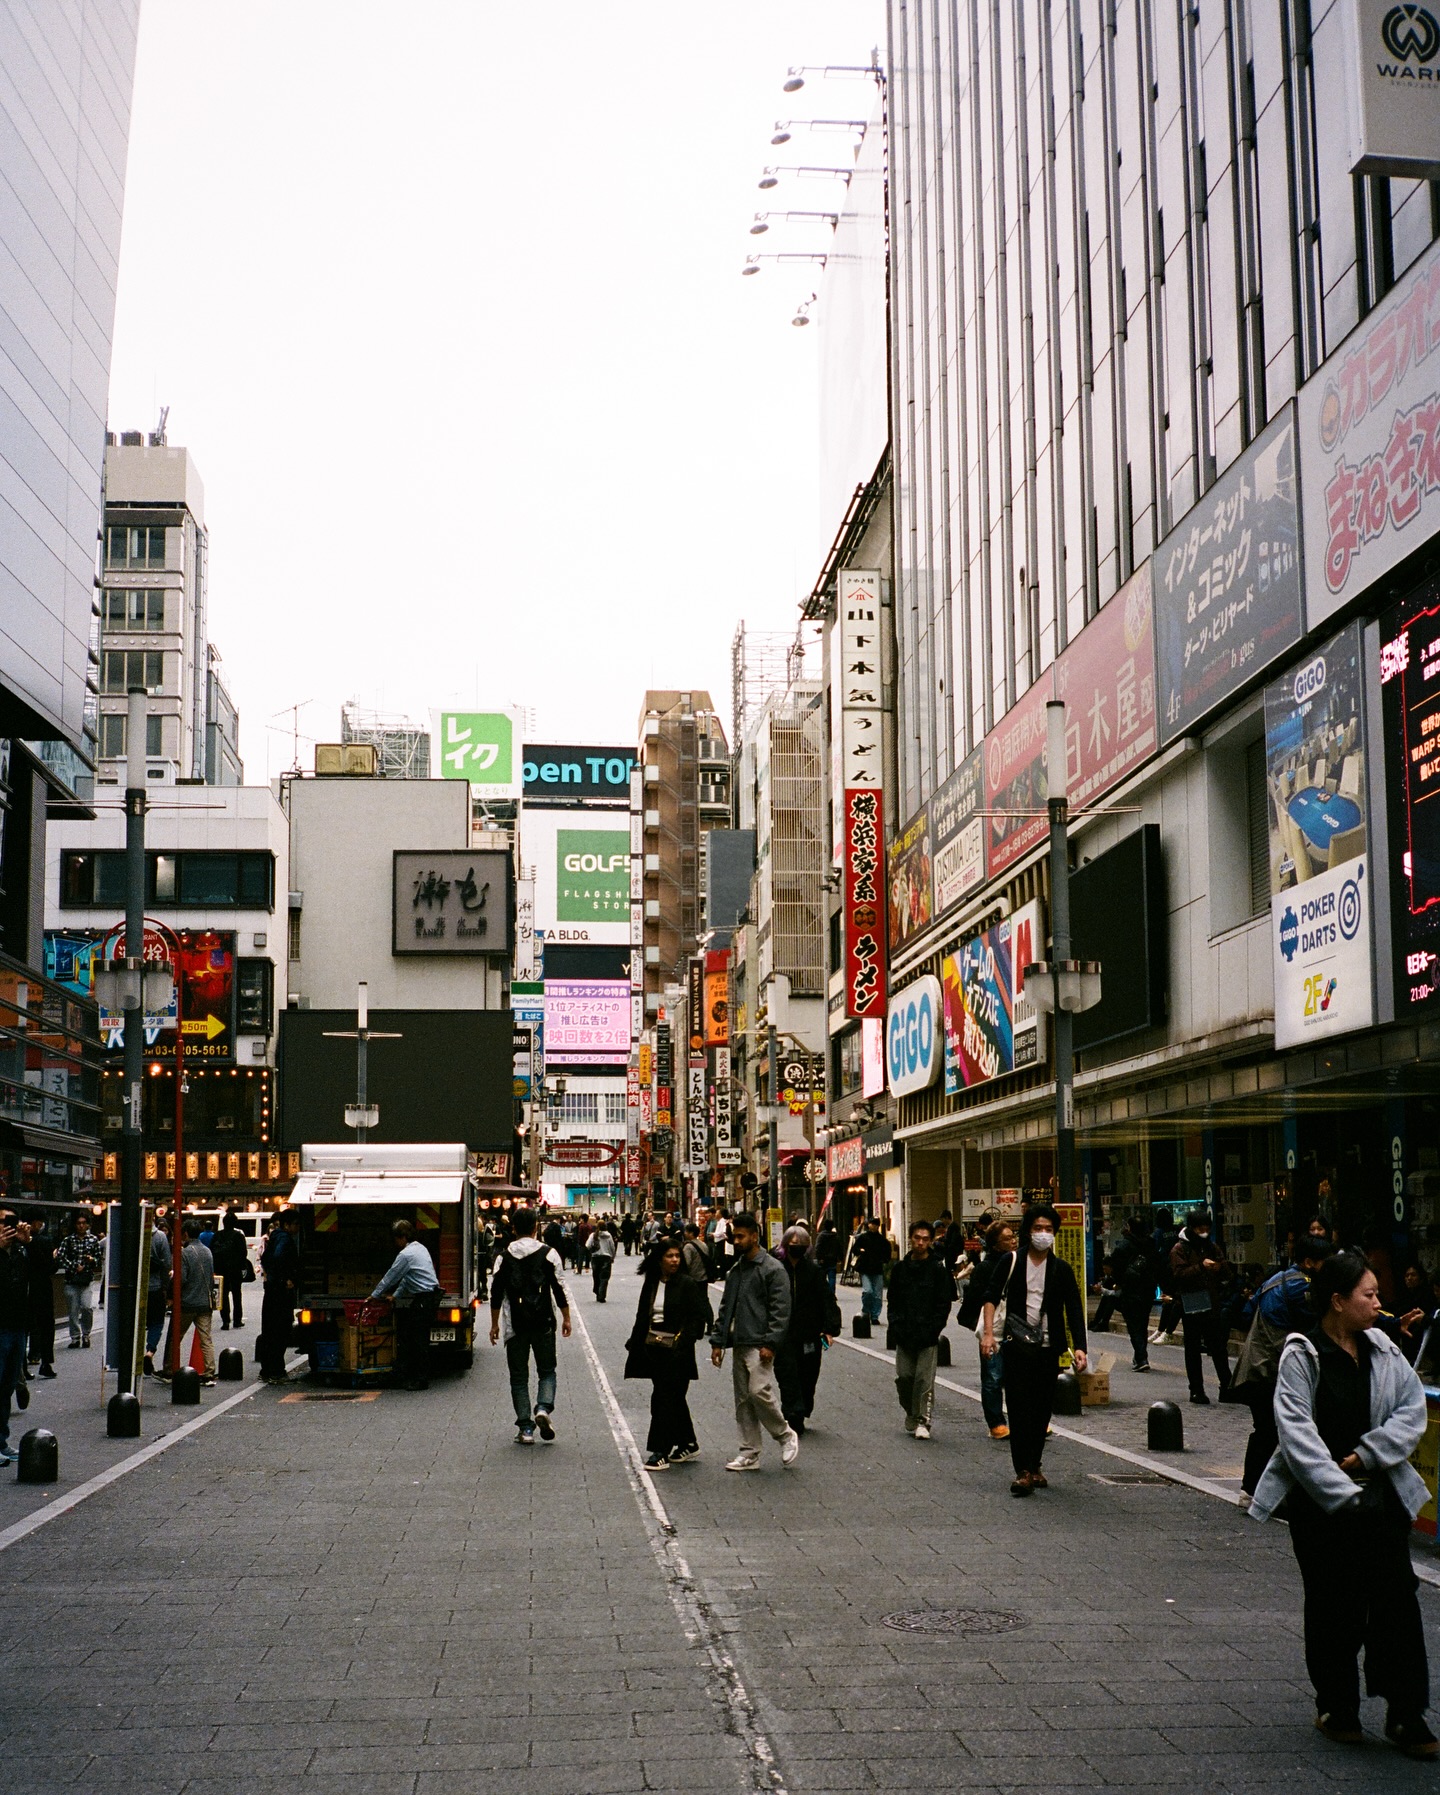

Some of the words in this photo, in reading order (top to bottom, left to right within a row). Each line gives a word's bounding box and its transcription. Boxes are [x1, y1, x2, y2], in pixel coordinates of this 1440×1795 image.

[1377, 64, 1440, 81] WAR
[1165, 476, 1251, 593] インターネット
[1187, 529, 1251, 625] &コミック
[1166, 688, 1181, 725] 4F
[850, 793, 878, 902] 横浜家系
[564, 890, 629, 898] FLAGSHI
[1301, 892, 1336, 924] POKER
[1301, 923, 1337, 953] DARTS
[853, 934, 878, 1013] ラーメン
[962, 943, 994, 983] ゲームの
[549, 1001, 620, 1012] 1位アーティストの
[966, 980, 1000, 1027] オアシスに
[1303, 973, 1323, 1017] 2F
[107, 1028, 160, 1049] KV
[561, 1015, 608, 1026] 推し広告は
[890, 992, 933, 1082] GiGO
[691, 1117, 704, 1166] にいむら
